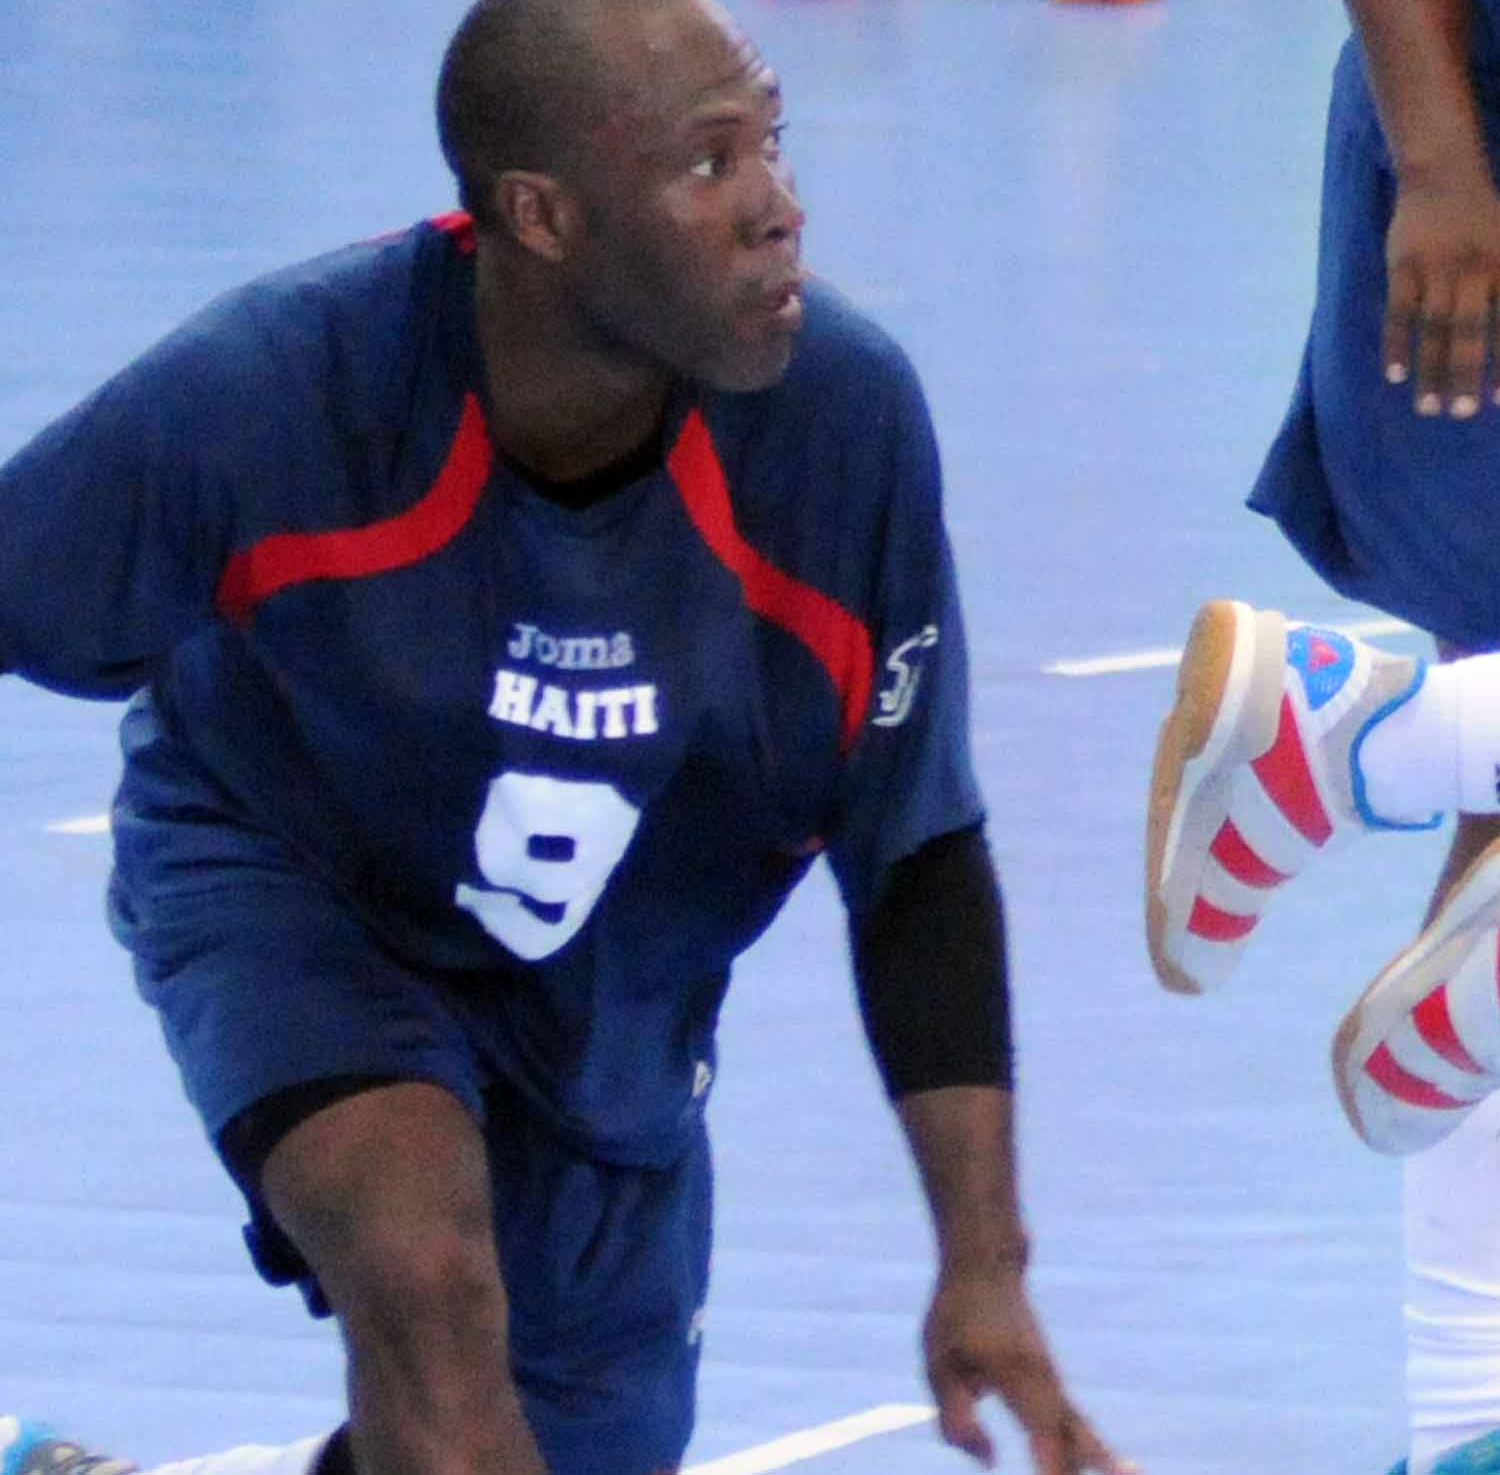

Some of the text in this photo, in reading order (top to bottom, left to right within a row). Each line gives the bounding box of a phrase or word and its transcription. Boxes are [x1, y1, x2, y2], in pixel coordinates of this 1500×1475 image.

[508, 624, 636, 670] Joma
[488, 669, 659, 740] HAITI
[455, 770, 641, 961] 9
